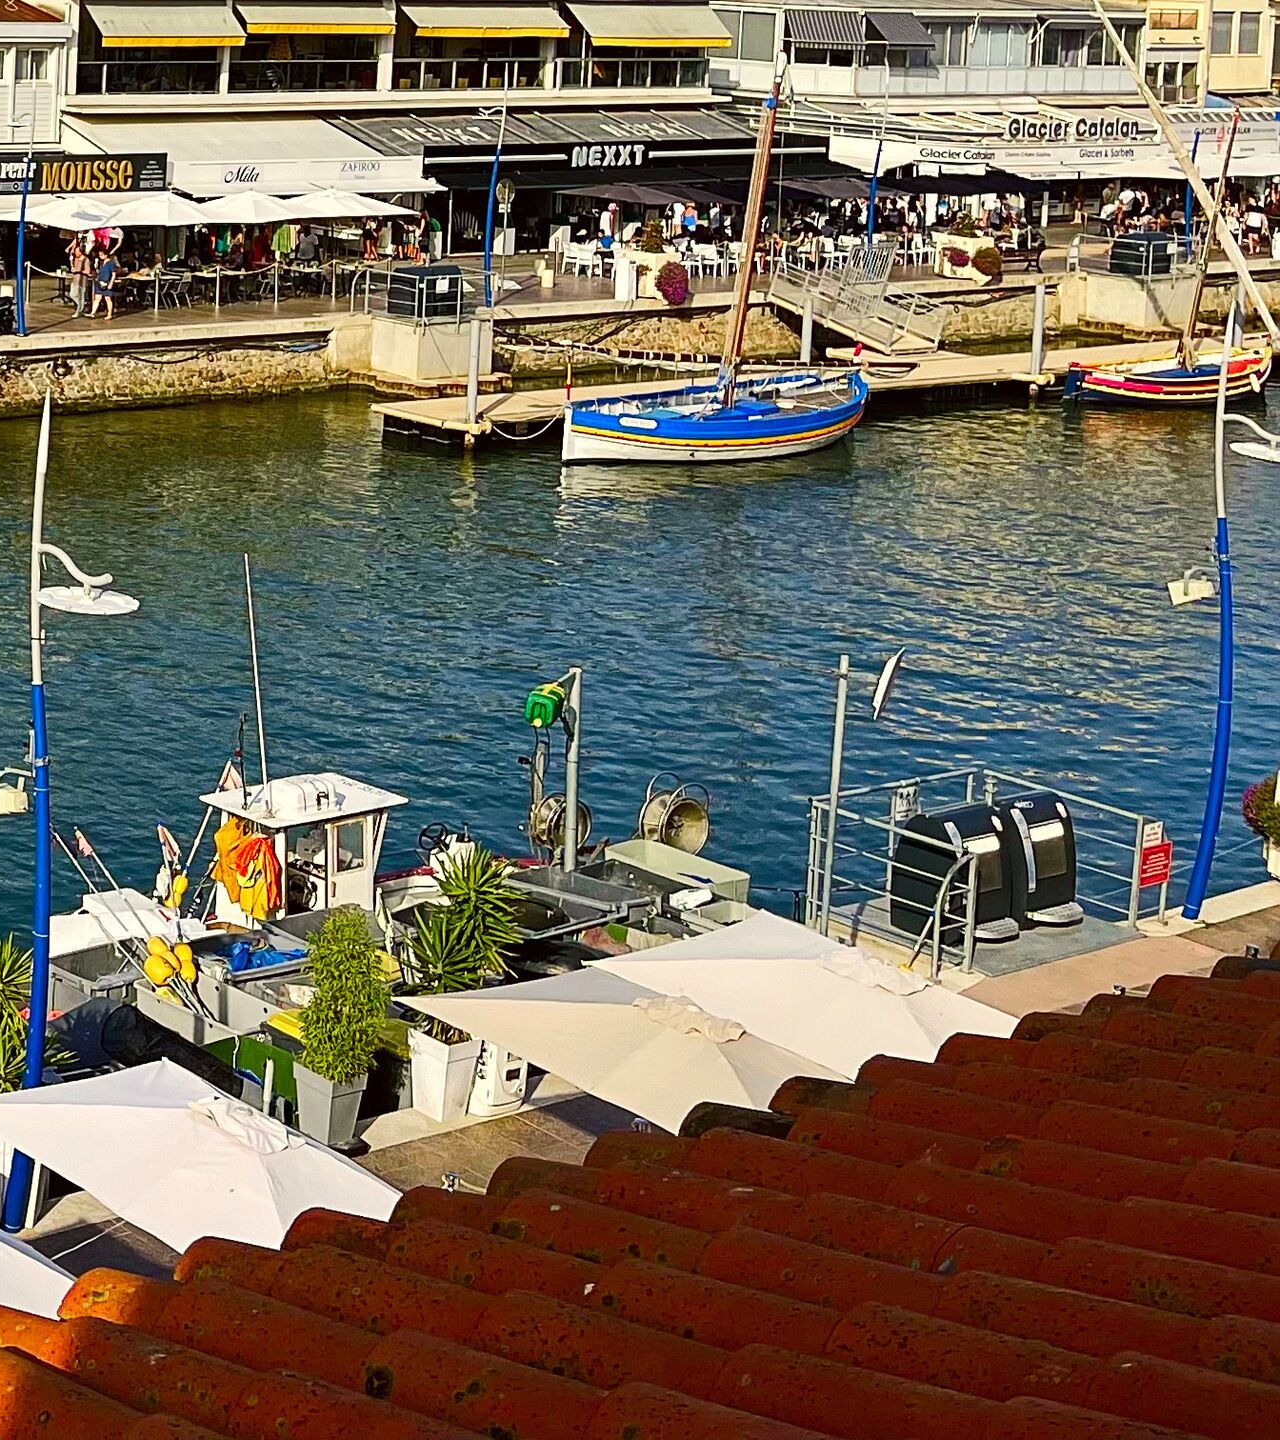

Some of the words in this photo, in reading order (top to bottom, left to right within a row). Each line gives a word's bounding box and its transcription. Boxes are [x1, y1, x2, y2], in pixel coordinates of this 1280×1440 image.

[1008, 116, 1070, 137] Glacier
[1075, 118, 1139, 137] Catalan
[571, 144, 646, 167] NEXXT
[919, 147, 961, 159] Glacier
[223, 165, 260, 184] Mila
